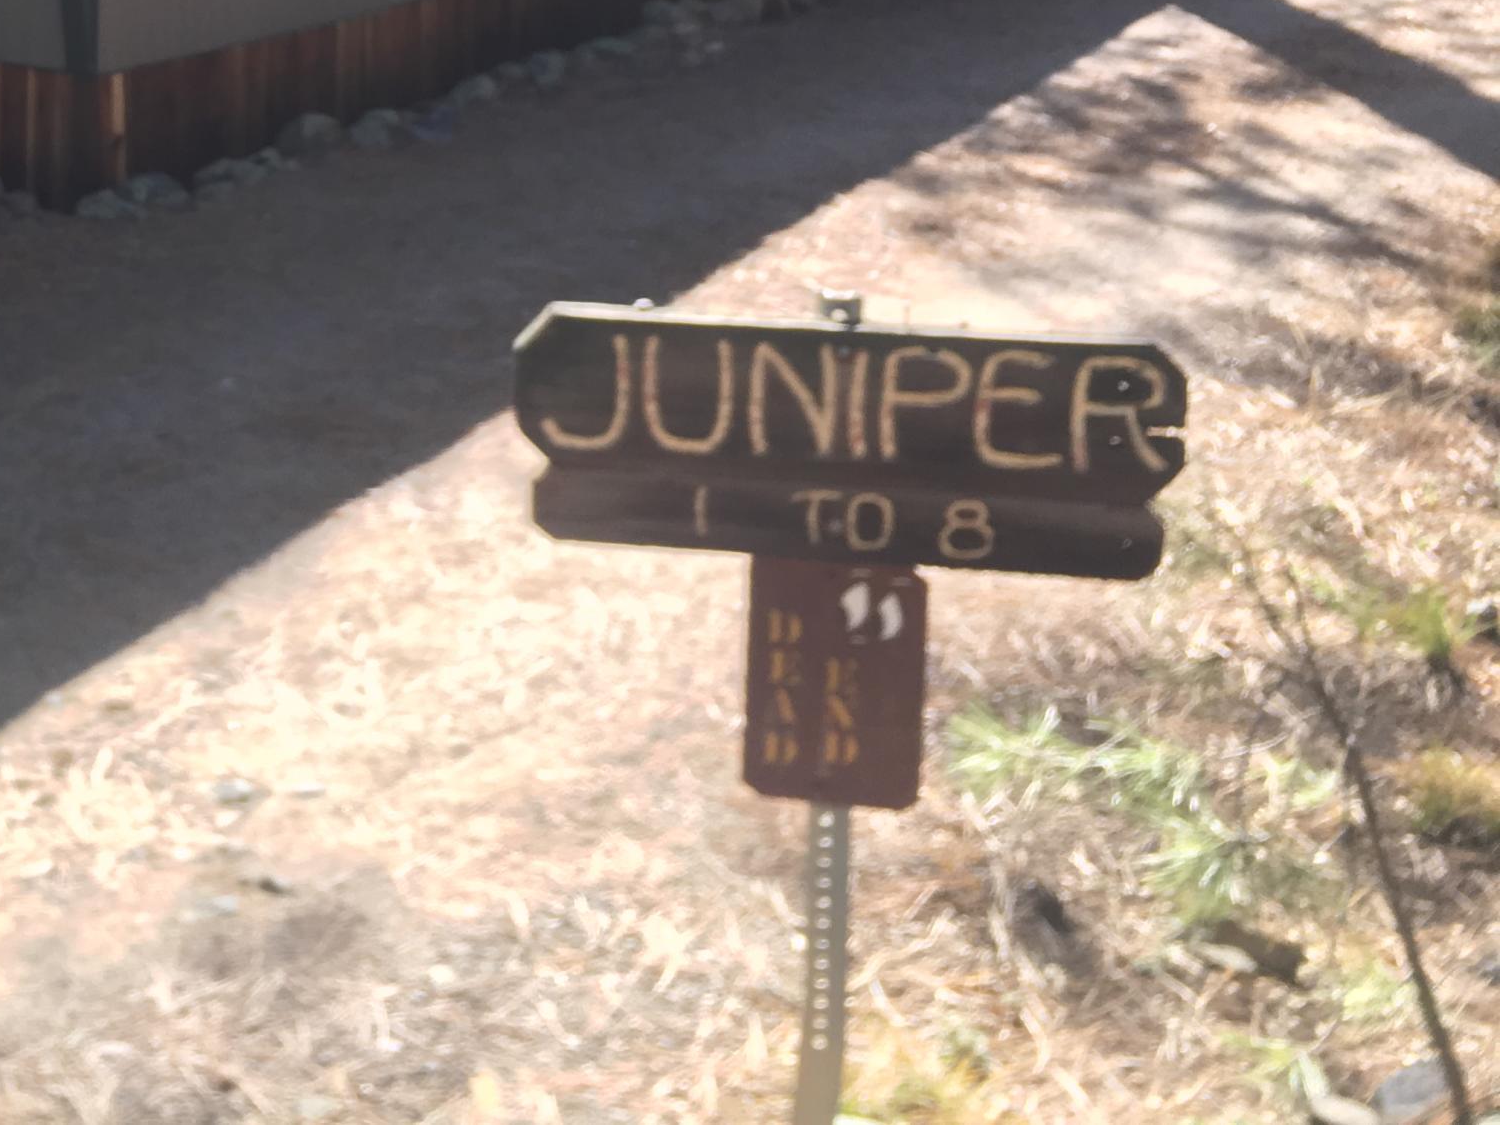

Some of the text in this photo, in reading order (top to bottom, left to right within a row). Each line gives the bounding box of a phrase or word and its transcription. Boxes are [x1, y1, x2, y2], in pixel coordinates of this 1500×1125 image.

[541, 334, 1169, 473] JUNIPER
[794, 488, 894, 551] TO
[938, 499, 994, 560] 8
